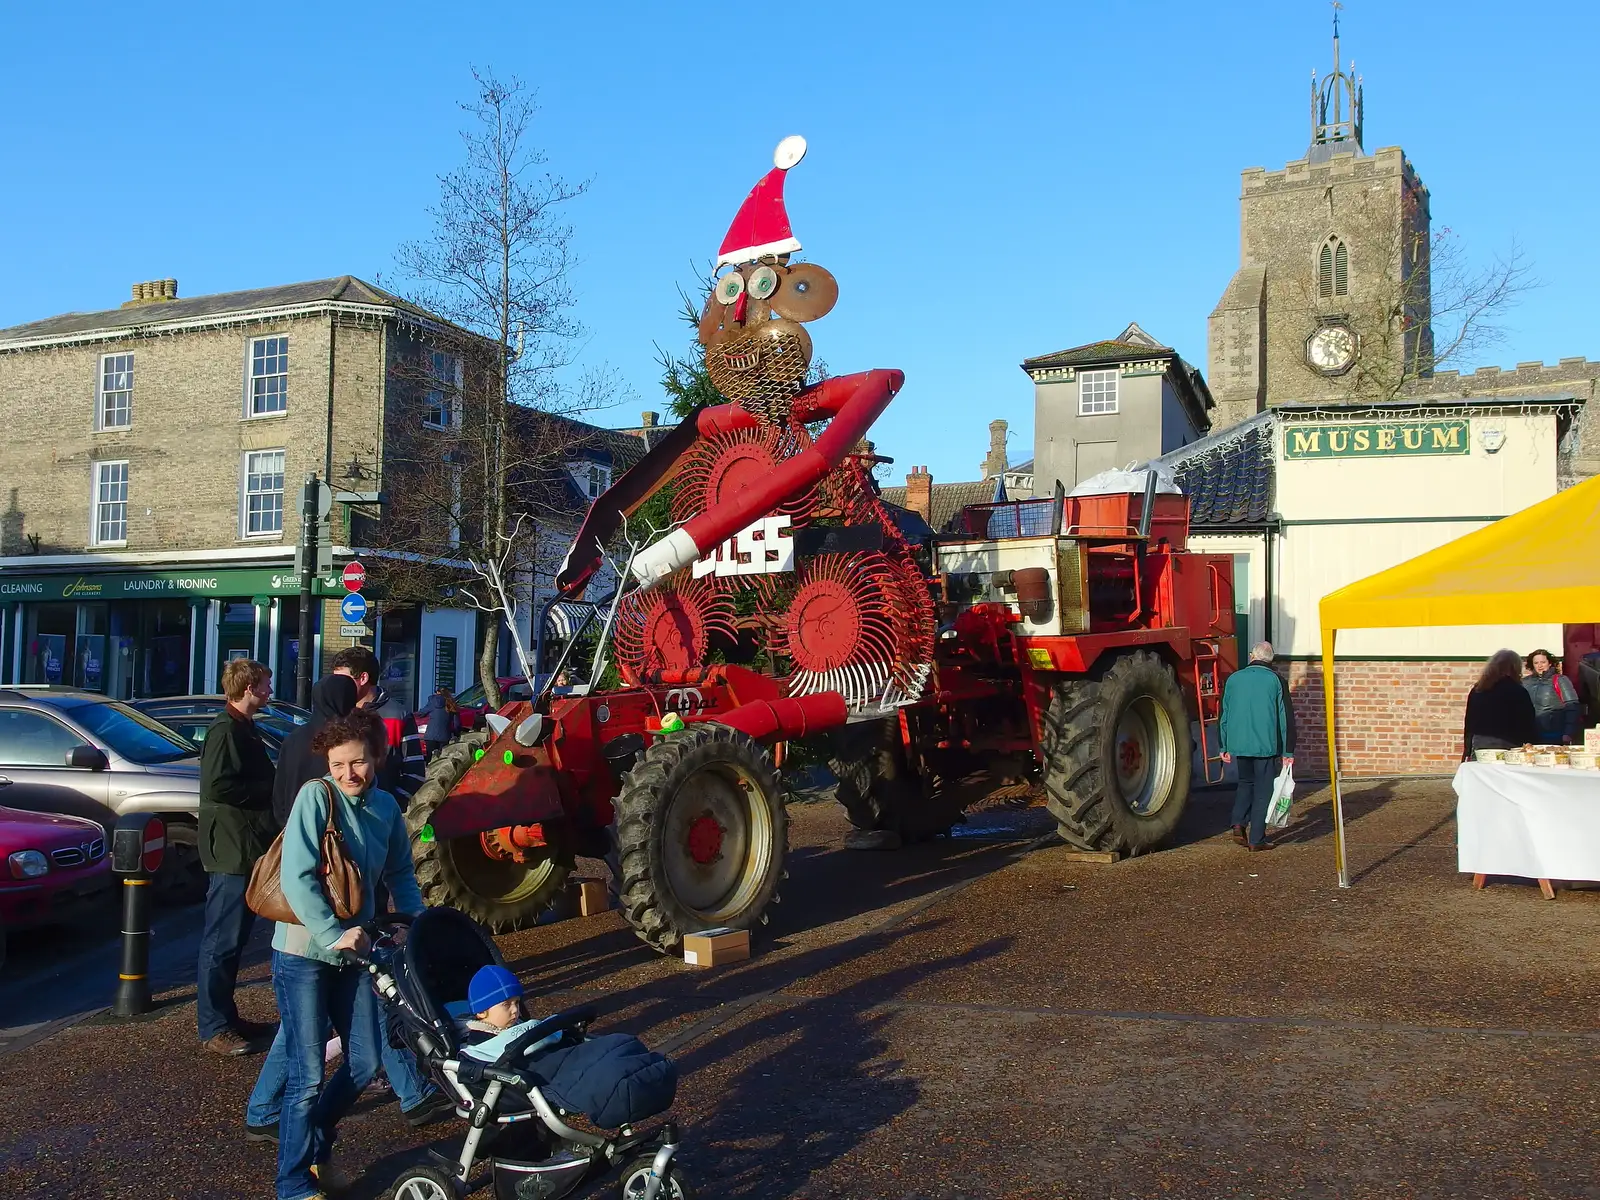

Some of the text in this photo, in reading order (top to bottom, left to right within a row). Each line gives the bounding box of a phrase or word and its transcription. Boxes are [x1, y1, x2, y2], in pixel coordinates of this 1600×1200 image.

[1293, 427, 1460, 452] MUSEUM
[1, 583, 43, 593] CLEANING
[62, 577, 102, 596] Johnsons
[124, 578, 218, 591] LAUNDRY & IRONING
